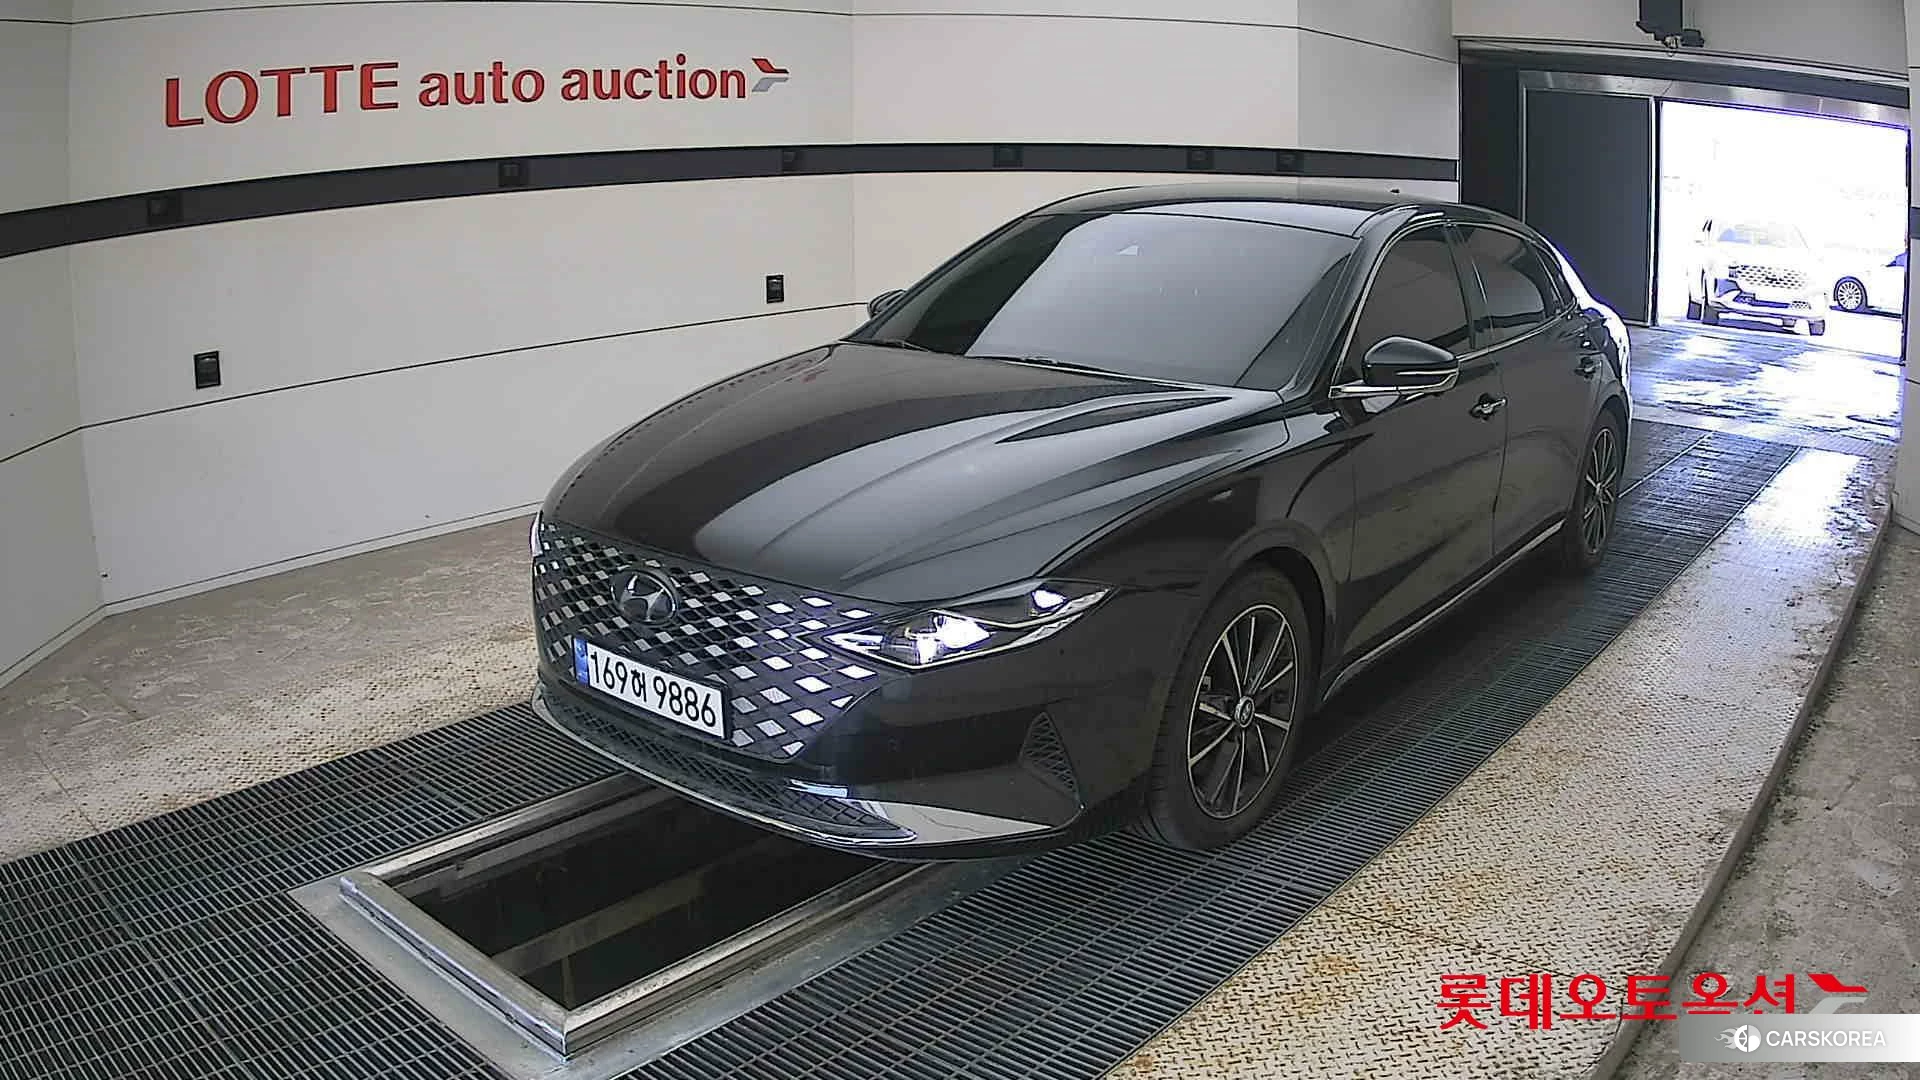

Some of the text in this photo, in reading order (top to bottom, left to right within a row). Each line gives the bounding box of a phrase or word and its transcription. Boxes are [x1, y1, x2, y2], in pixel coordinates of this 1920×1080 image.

[164, 53, 747, 128] LOTTE auto auction
[590, 651, 717, 728] 169허 9886
